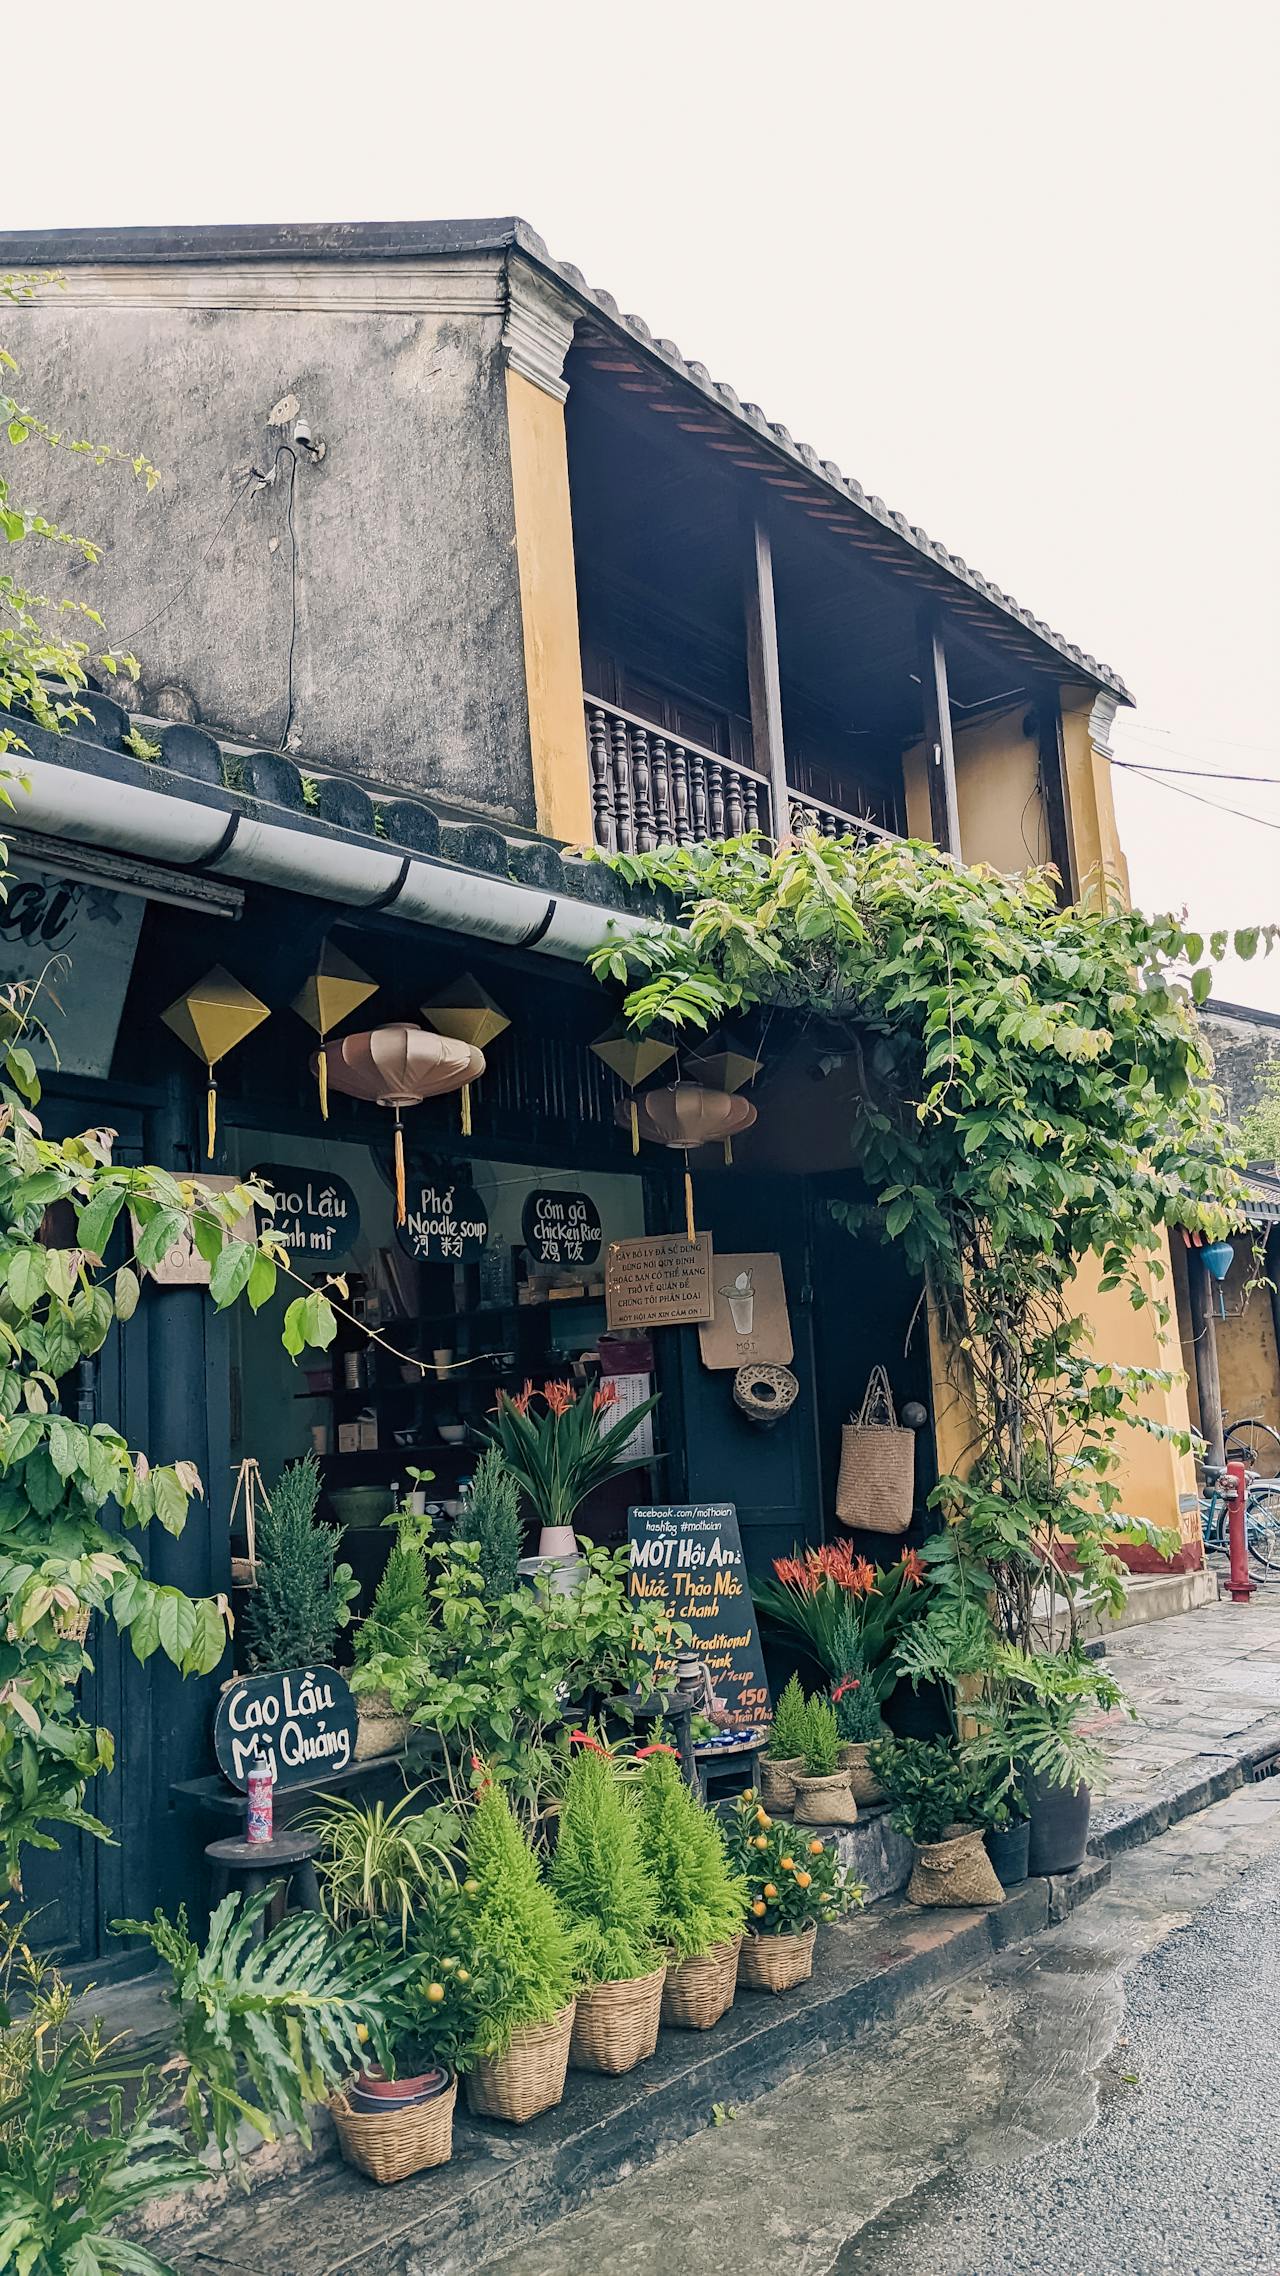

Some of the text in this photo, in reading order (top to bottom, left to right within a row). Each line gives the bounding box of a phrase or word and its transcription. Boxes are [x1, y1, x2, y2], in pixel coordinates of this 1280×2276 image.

[273, 1183, 348, 1218] ao Lầu
[310, 1226, 337, 1250] mì
[407, 1212, 487, 1245] Noodle soup
[580, 1223, 602, 1242] Rice
[413, 1234, 464, 1258] 河粉
[540, 1240, 585, 1262] 鸡饭
[630, 1534, 678, 1568] MÓT
[677, 1538, 706, 1571] Hội
[672, 1571, 712, 1597] Thảo
[713, 1570, 744, 1600] Mộc
[679, 1597, 720, 1619] chanh
[691, 1628, 752, 1651] traditional
[228, 1671, 336, 1732] Cao Lầu
[737, 1687, 768, 1706] 150
[280, 1720, 349, 1771] Quảng
